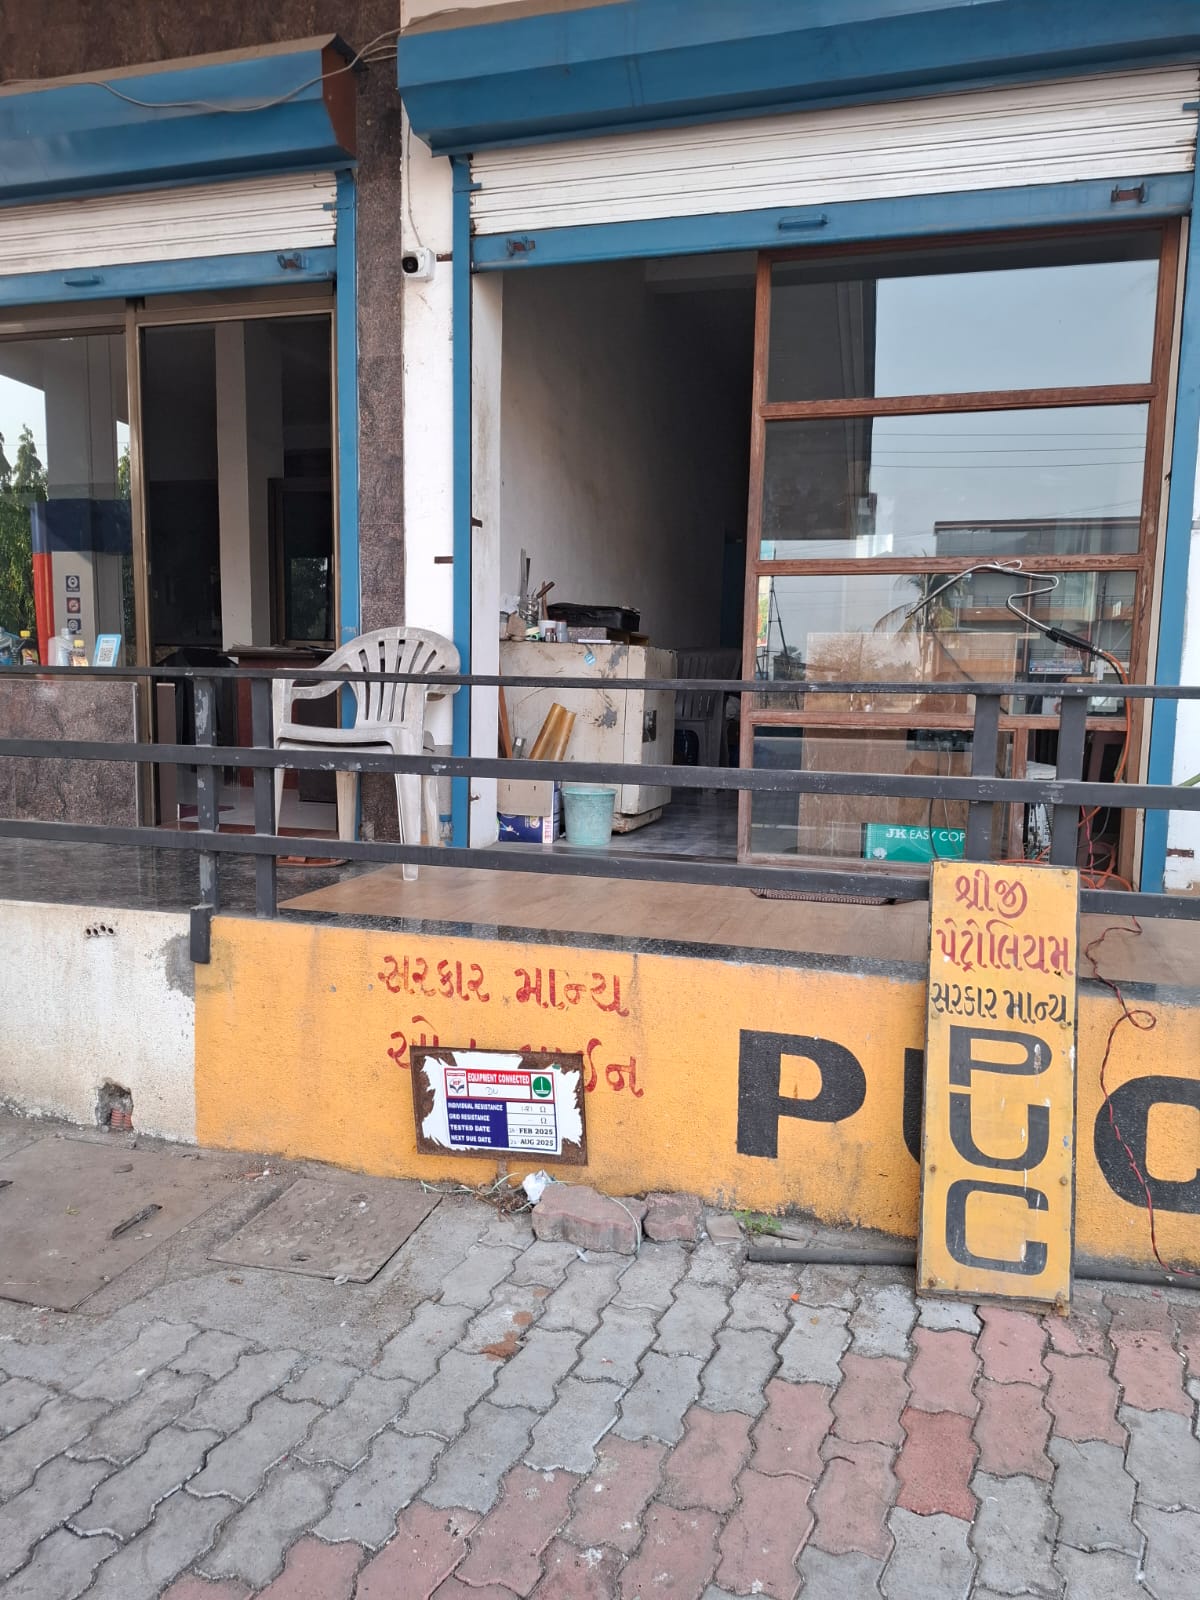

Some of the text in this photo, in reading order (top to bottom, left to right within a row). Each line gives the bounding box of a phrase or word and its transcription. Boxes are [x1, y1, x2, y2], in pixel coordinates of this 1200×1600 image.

[885, 828, 907, 839] JK
[954, 869, 1028, 919] શ્રીજી
[936, 918, 1074, 977] પેટ્રોલિયમ
[378, 955, 630, 1017] સરકાર માન્ય
[930, 982, 1073, 1026] સરકાર માન્ય
[467, 1072, 497, 1083] EQUIPMENT
[498, 1074, 530, 1084] CONNECTED
[448, 1102, 473, 1110] INDIVIDUAL
[474, 1103, 503, 1111] RESISTANCE
[461, 1114, 490, 1122] RESISTANCE
[475, 1125, 491, 1133] DATE
[519, 1127, 533, 1135] FEB
[520, 1138, 534, 1146] AUG
[536, 1139, 554, 1147] 2025
[946, 1025, 1052, 1276] PUC
